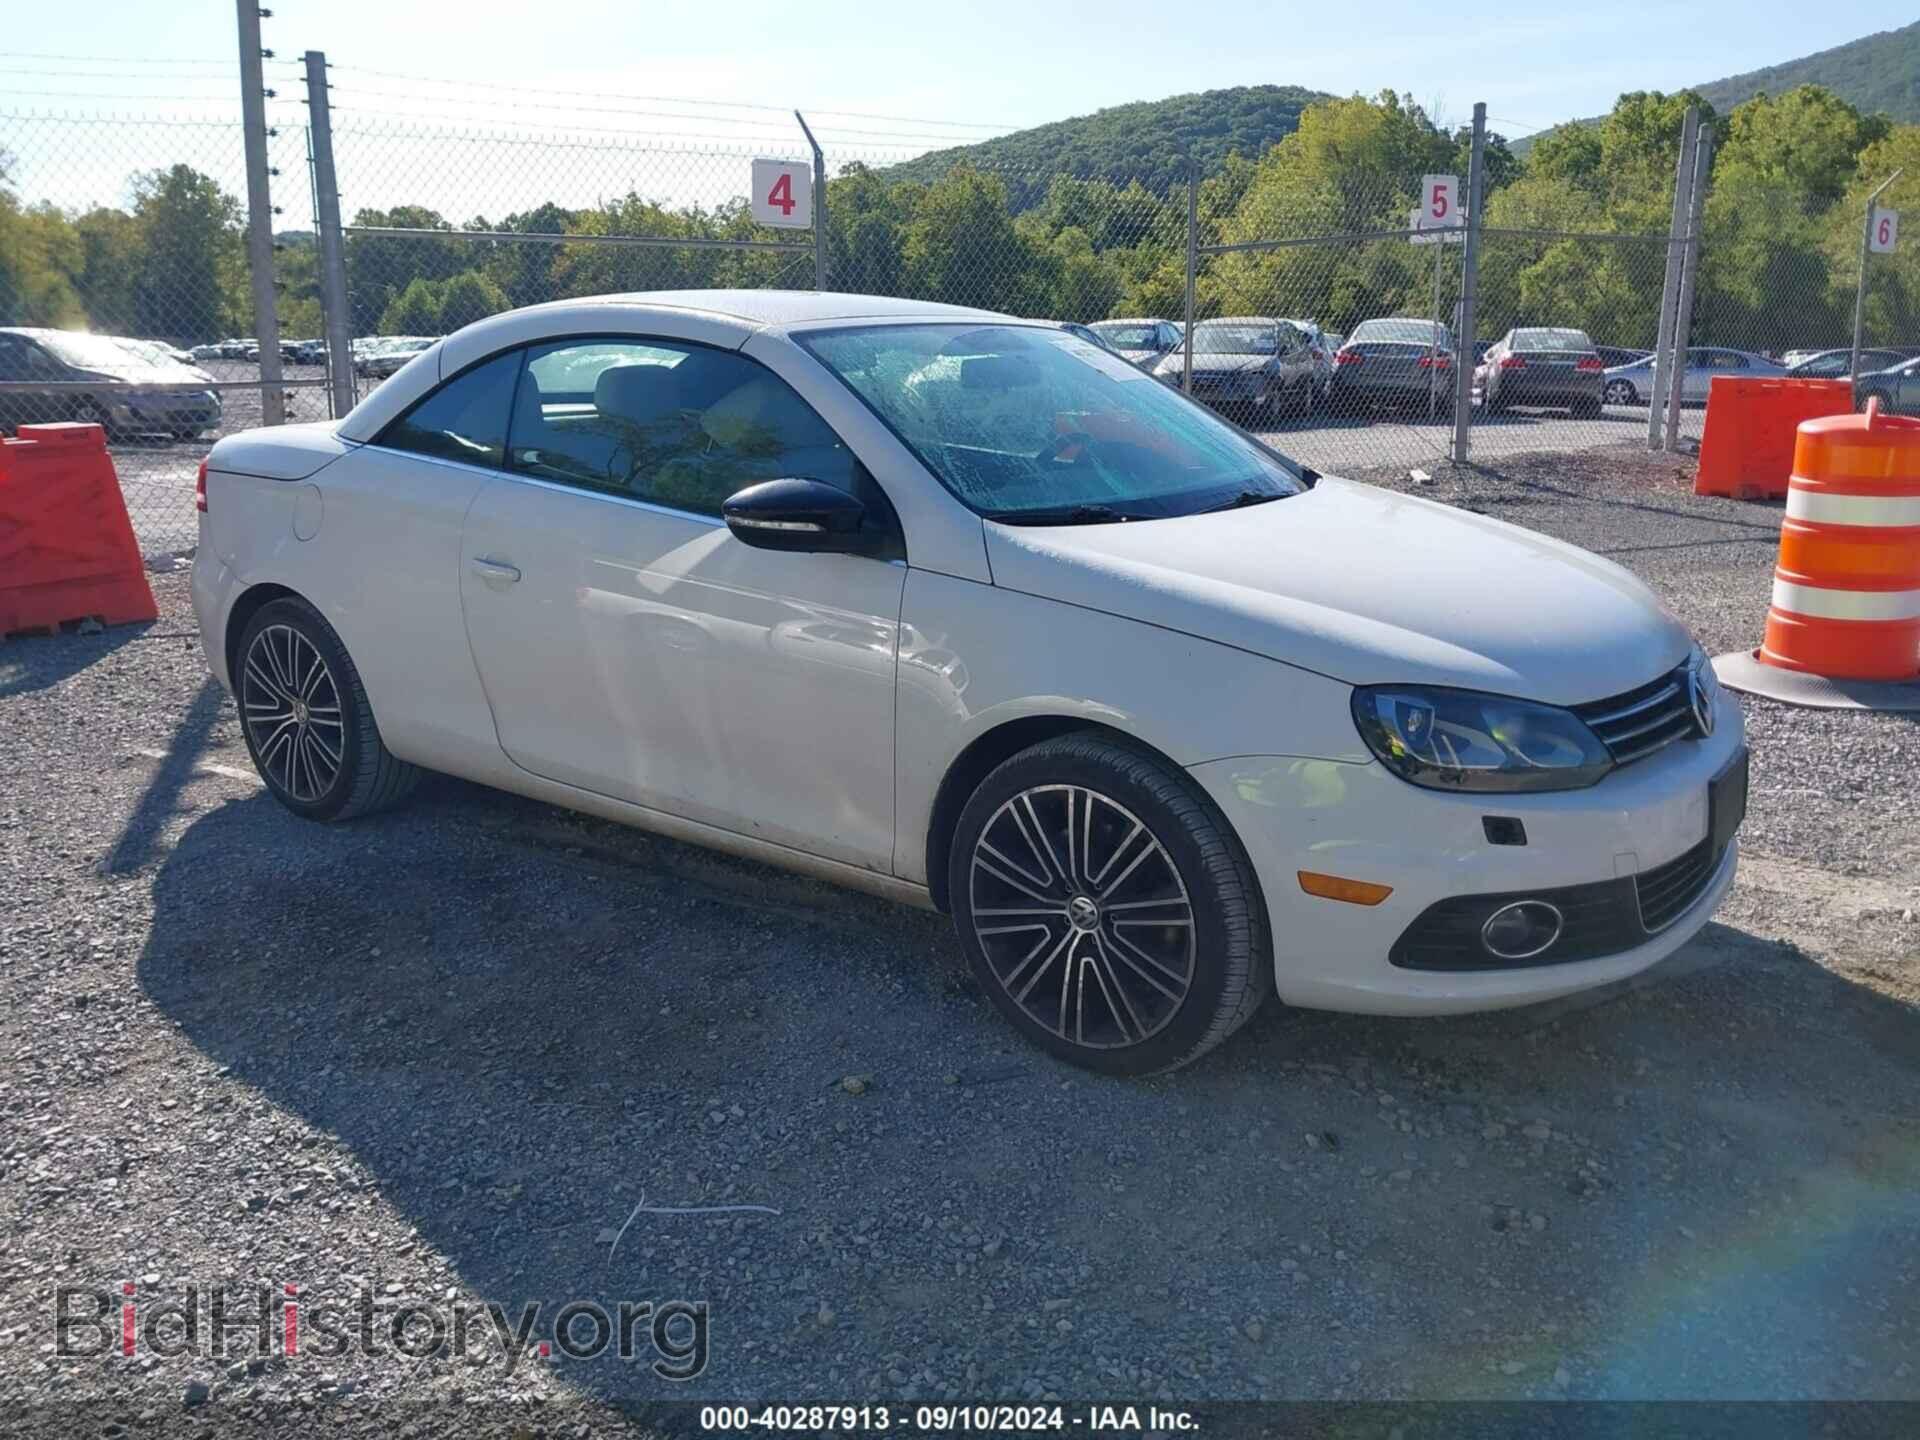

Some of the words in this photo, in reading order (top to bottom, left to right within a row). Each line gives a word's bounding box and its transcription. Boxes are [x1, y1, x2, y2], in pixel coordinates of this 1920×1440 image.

[768, 174, 796, 215] 4
[1432, 185, 1448, 218] 5
[1879, 218, 1890, 245] 6
